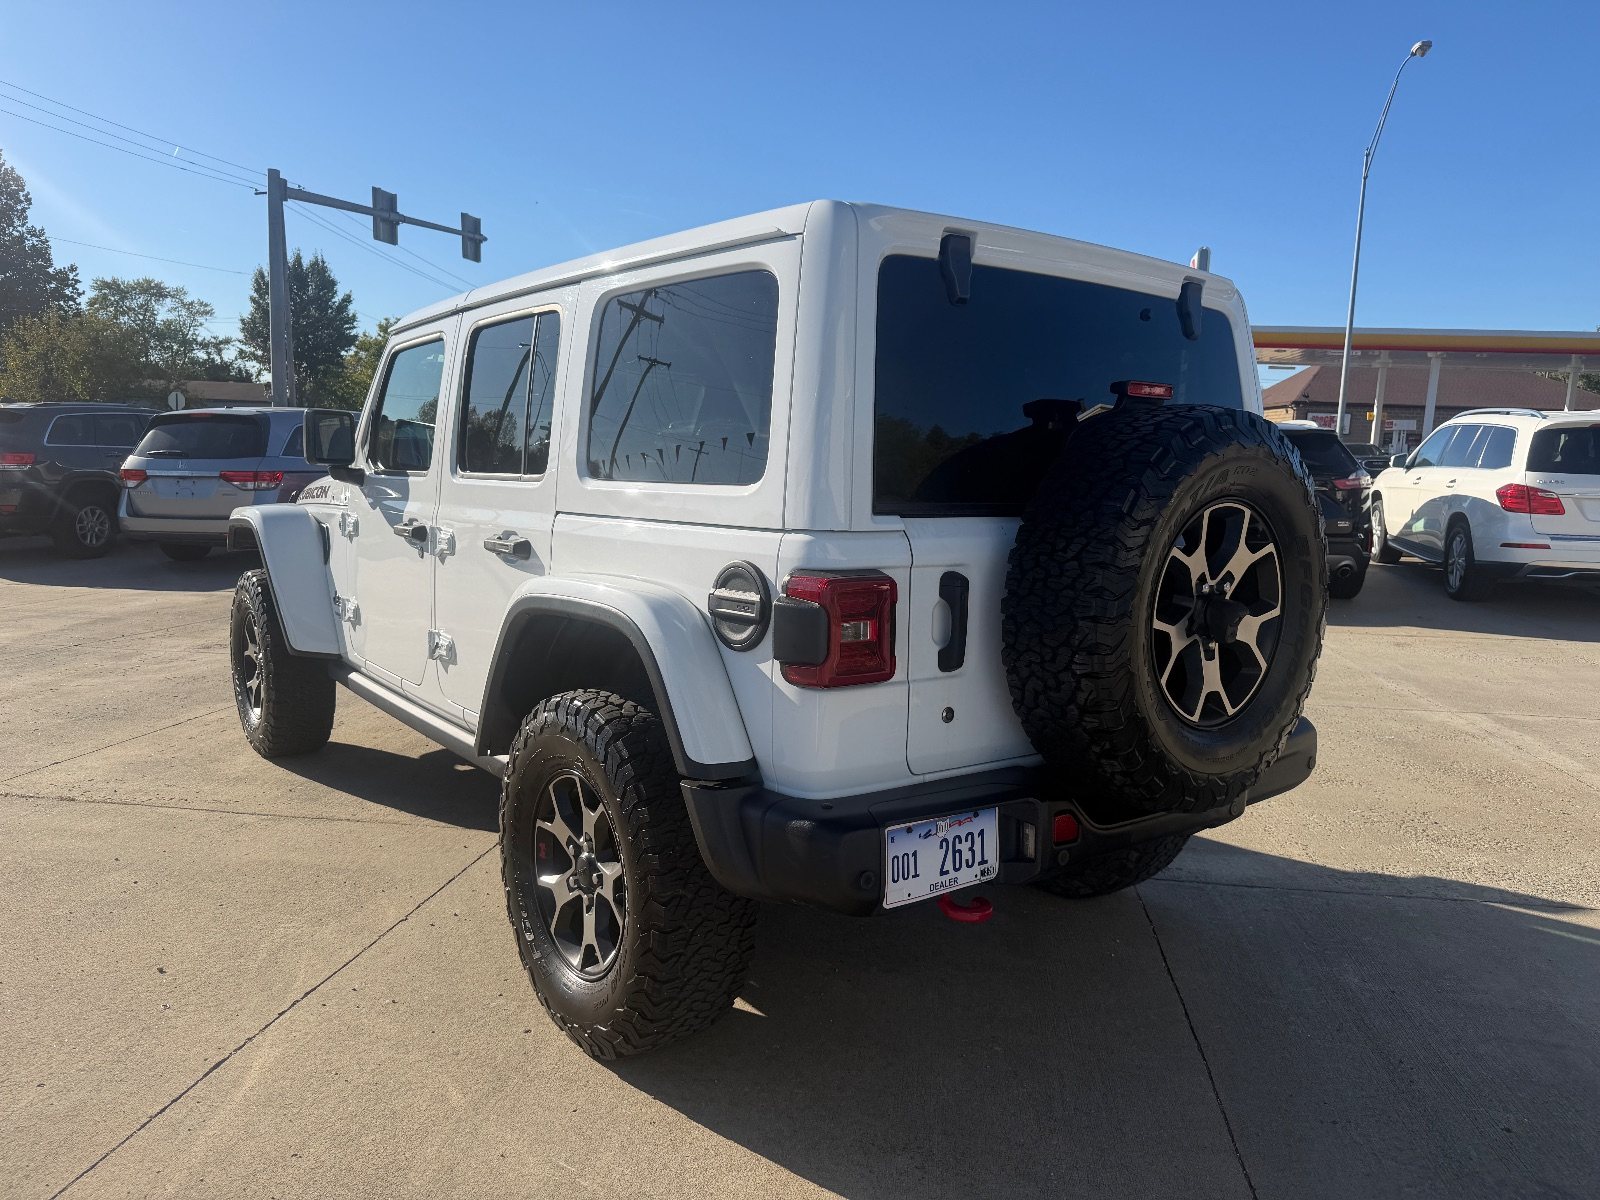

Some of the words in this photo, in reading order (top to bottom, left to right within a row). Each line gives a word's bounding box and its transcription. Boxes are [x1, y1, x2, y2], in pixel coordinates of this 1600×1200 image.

[891, 849, 920, 884] 001
[939, 828, 989, 877] 2631
[929, 876, 959, 892] DEALER
